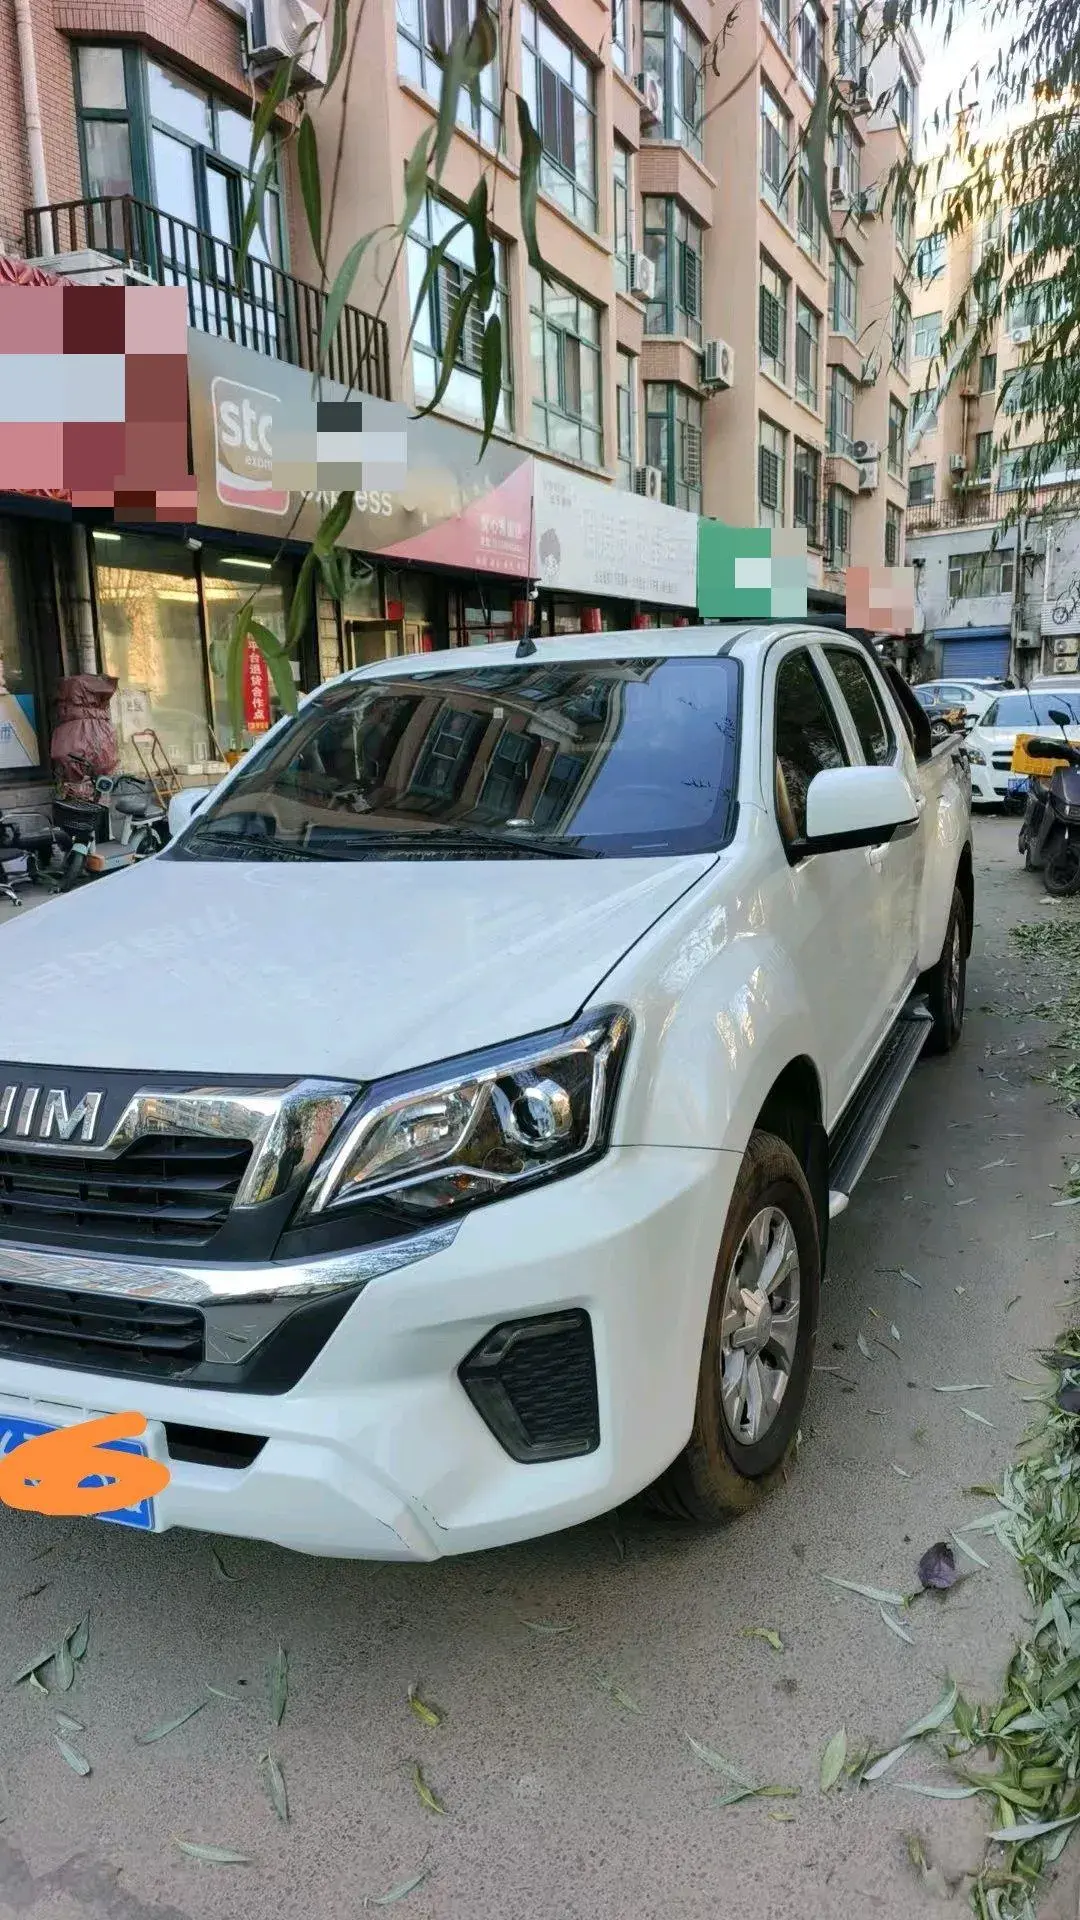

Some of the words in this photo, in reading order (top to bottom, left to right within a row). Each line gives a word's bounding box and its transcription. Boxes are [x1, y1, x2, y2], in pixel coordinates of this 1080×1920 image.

[247, 632, 265, 720] 平台退货合作点
